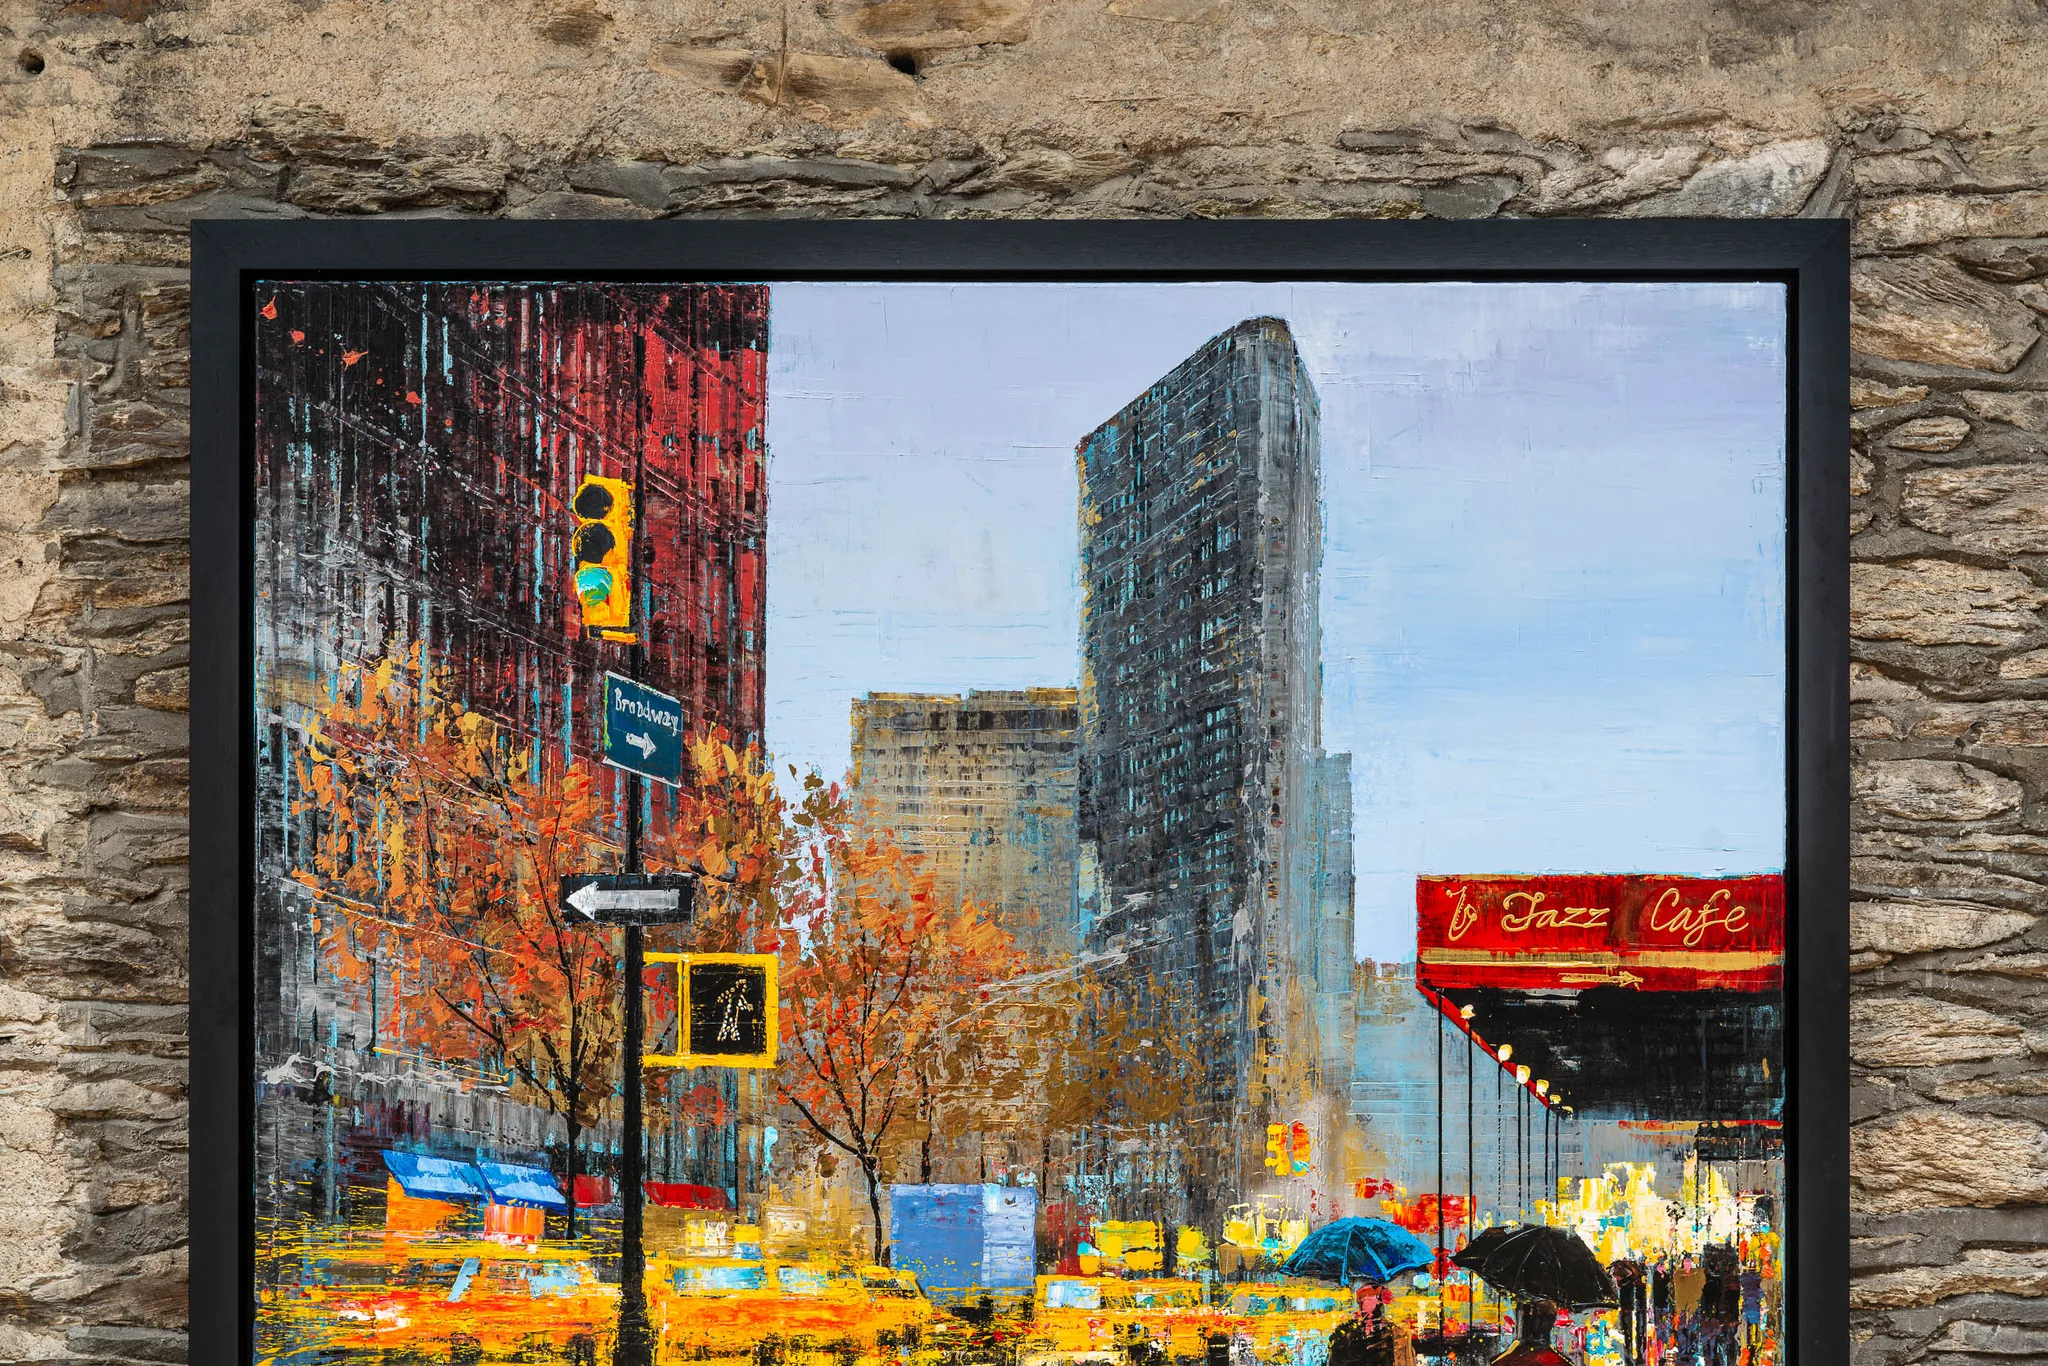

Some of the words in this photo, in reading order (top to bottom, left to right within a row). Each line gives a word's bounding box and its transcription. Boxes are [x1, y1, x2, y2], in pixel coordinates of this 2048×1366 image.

[614, 688, 679, 736] Broadway
[1501, 892, 1611, 932] Jazz
[1651, 887, 1749, 946] Cafe
